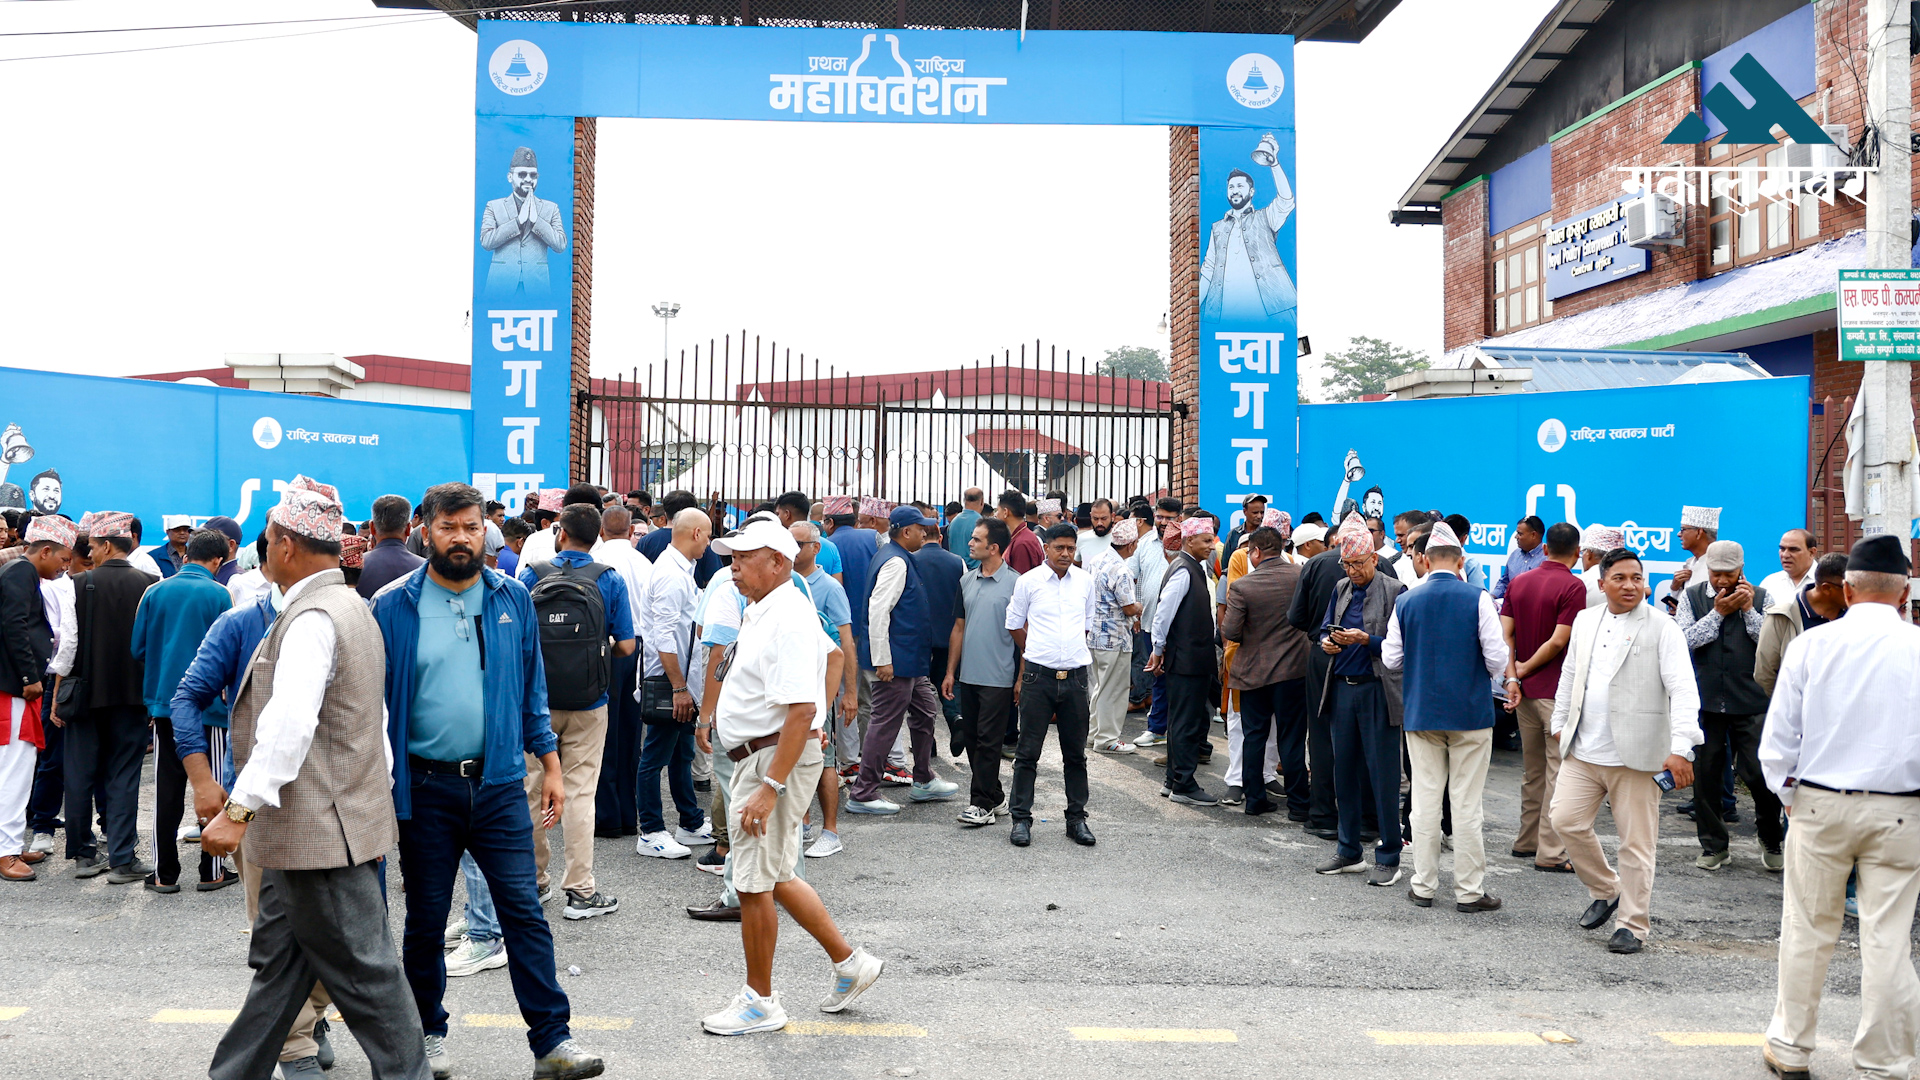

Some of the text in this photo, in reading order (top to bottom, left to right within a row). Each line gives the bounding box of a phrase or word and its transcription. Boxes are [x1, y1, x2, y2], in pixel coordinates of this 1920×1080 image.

[769, 34, 1008, 116] महाधिवेशन
[808, 56, 966, 76] प्रथम राष्ट्रिय
[1548, 249, 1561, 269] Nepal
[1562, 244, 1581, 263] Poultry
[1571, 261, 1594, 277] Central
[1844, 289, 1859, 308] एस.
[1861, 289, 1879, 307] एण्ड
[1881, 283, 1892, 306] पी.
[286, 428, 379, 446] राष्ट्रिय स्वतन्त्र पार्टी
[1570, 424, 1675, 442] राष्ट्रिय स्वतन्त्र पार्टी
[1465, 523, 1507, 547] थम
[549, 613, 565, 623] CAT
